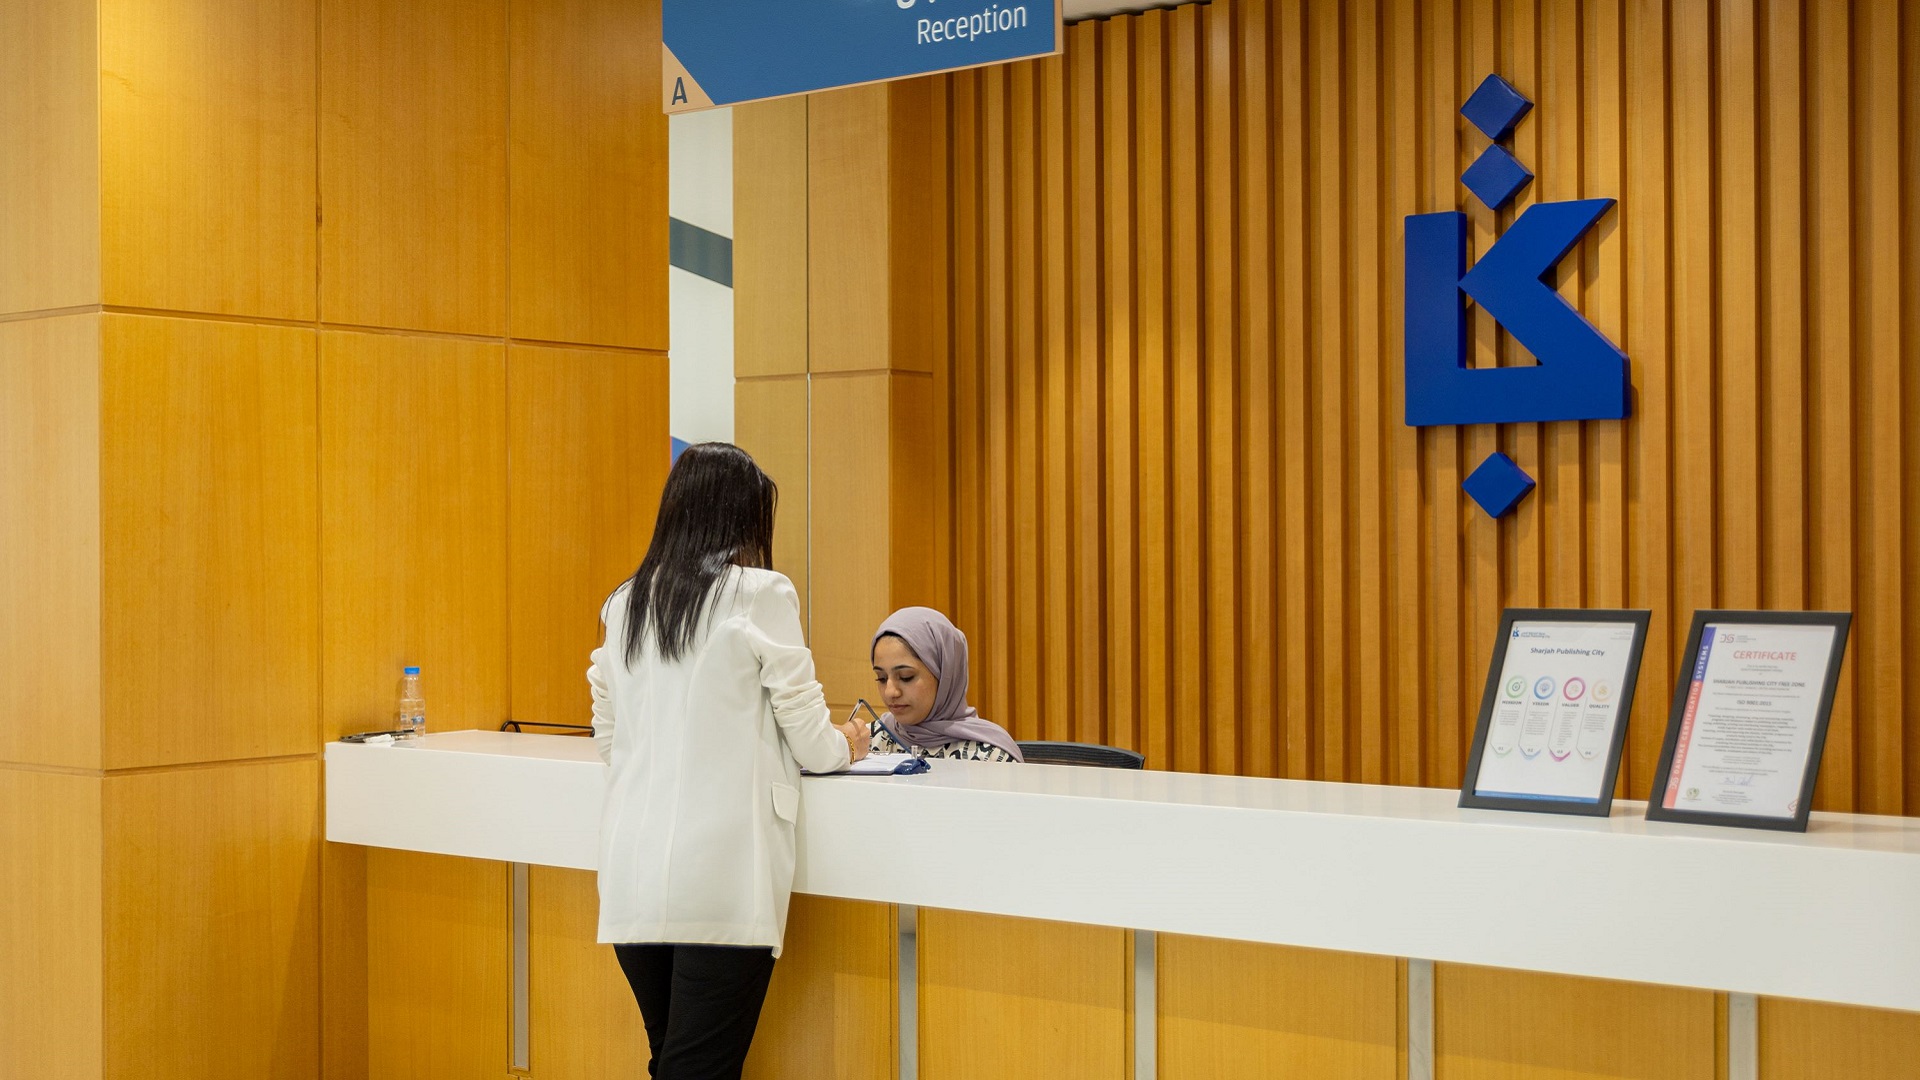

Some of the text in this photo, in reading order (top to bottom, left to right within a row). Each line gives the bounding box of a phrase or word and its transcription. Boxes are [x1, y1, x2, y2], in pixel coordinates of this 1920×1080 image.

[917, 4, 1027, 45] Reception
[671, 76, 689, 106] A
[1530, 647, 1555, 655] Sharjah
[1556, 648, 1590, 656] Publishing
[1733, 650, 1797, 661] CERTIFICATE
[1673, 744, 1685, 775] DANSKE
[1682, 681, 1700, 740] CERTIFICATION
[1695, 645, 1709, 679] SYSTEMS
